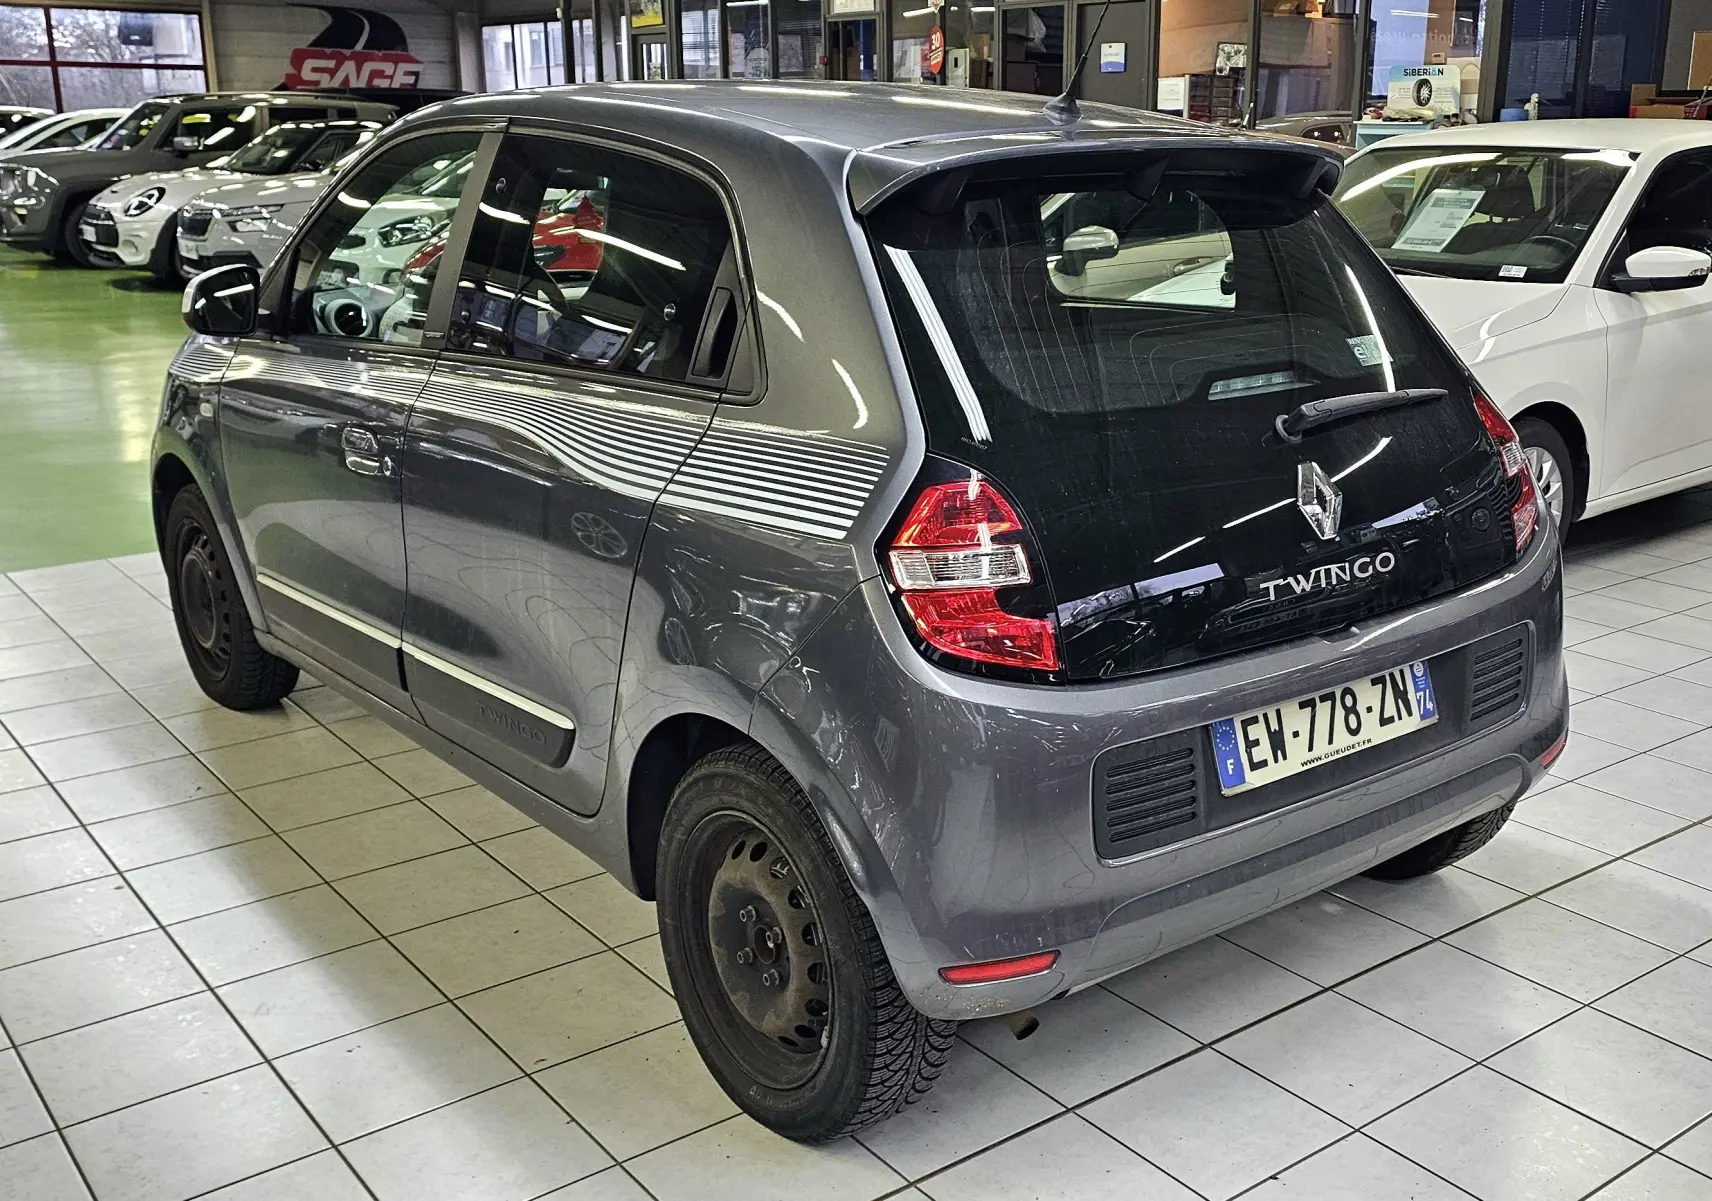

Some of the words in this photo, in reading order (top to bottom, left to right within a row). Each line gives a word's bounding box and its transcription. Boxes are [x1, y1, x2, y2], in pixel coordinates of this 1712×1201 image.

[1259, 551, 1395, 601] TWINGO
[1416, 689, 1434, 715] 74
[477, 703, 547, 745] TWINGO
[1240, 668, 1414, 773] EW-778-ZN
[1226, 758, 1235, 776] F
[1300, 738, 1373, 768] WWW.GUEUDET.FR
